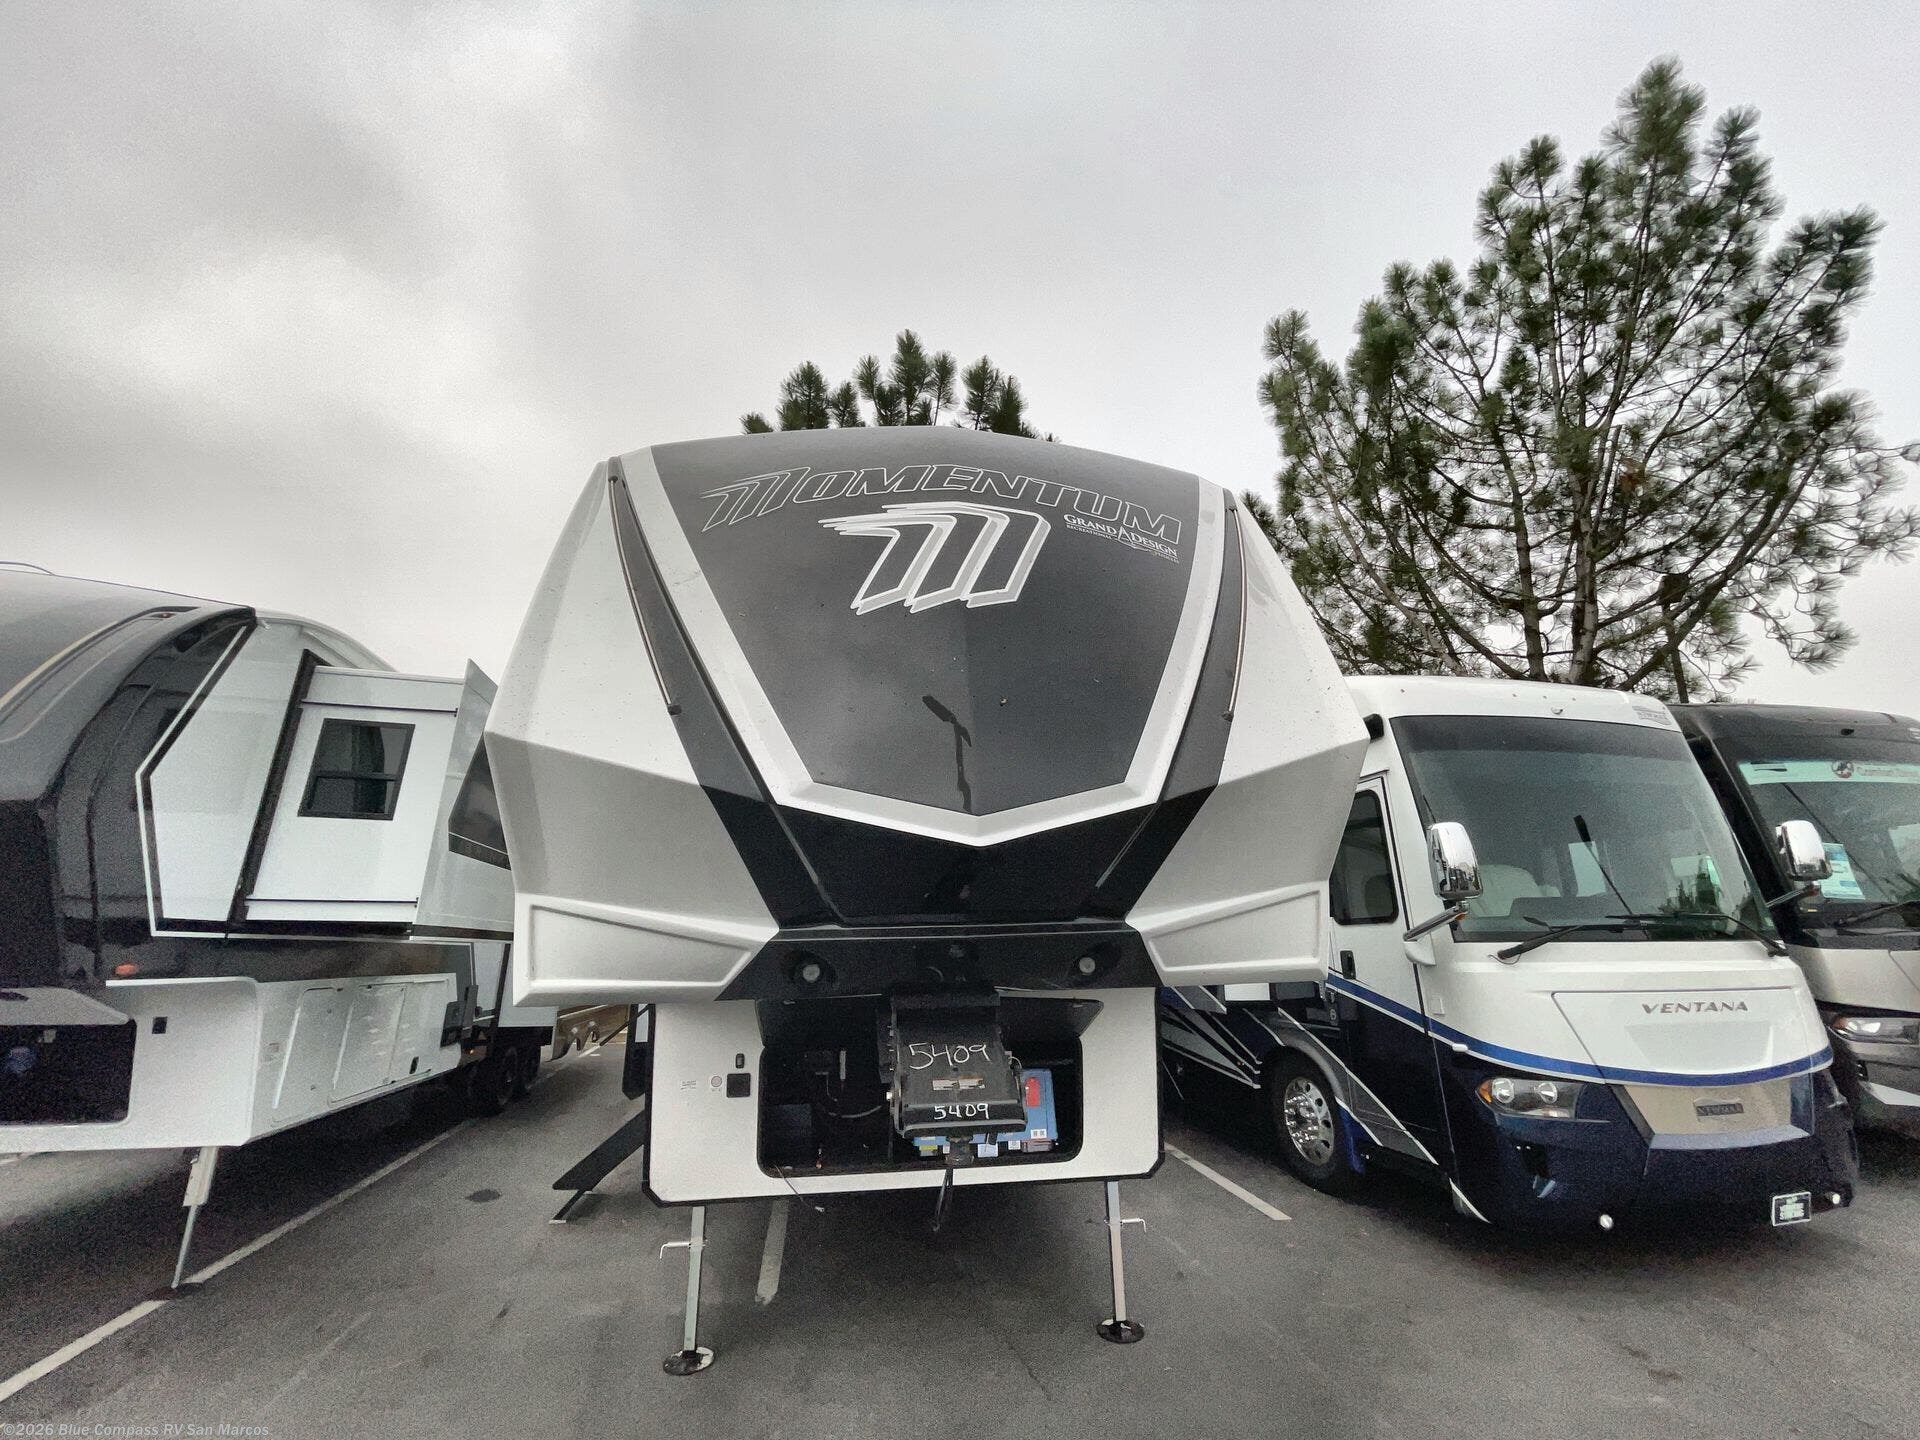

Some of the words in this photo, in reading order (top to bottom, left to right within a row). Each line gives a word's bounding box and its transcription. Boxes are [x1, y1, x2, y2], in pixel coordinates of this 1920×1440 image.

[700, 464, 1182, 545] MOMENTUM
[1063, 514, 1118, 535] GRAND
[1642, 1001, 1749, 1014] VENTANA
[908, 1042, 992, 1070] 5409
[933, 1103, 990, 1120] 5409
